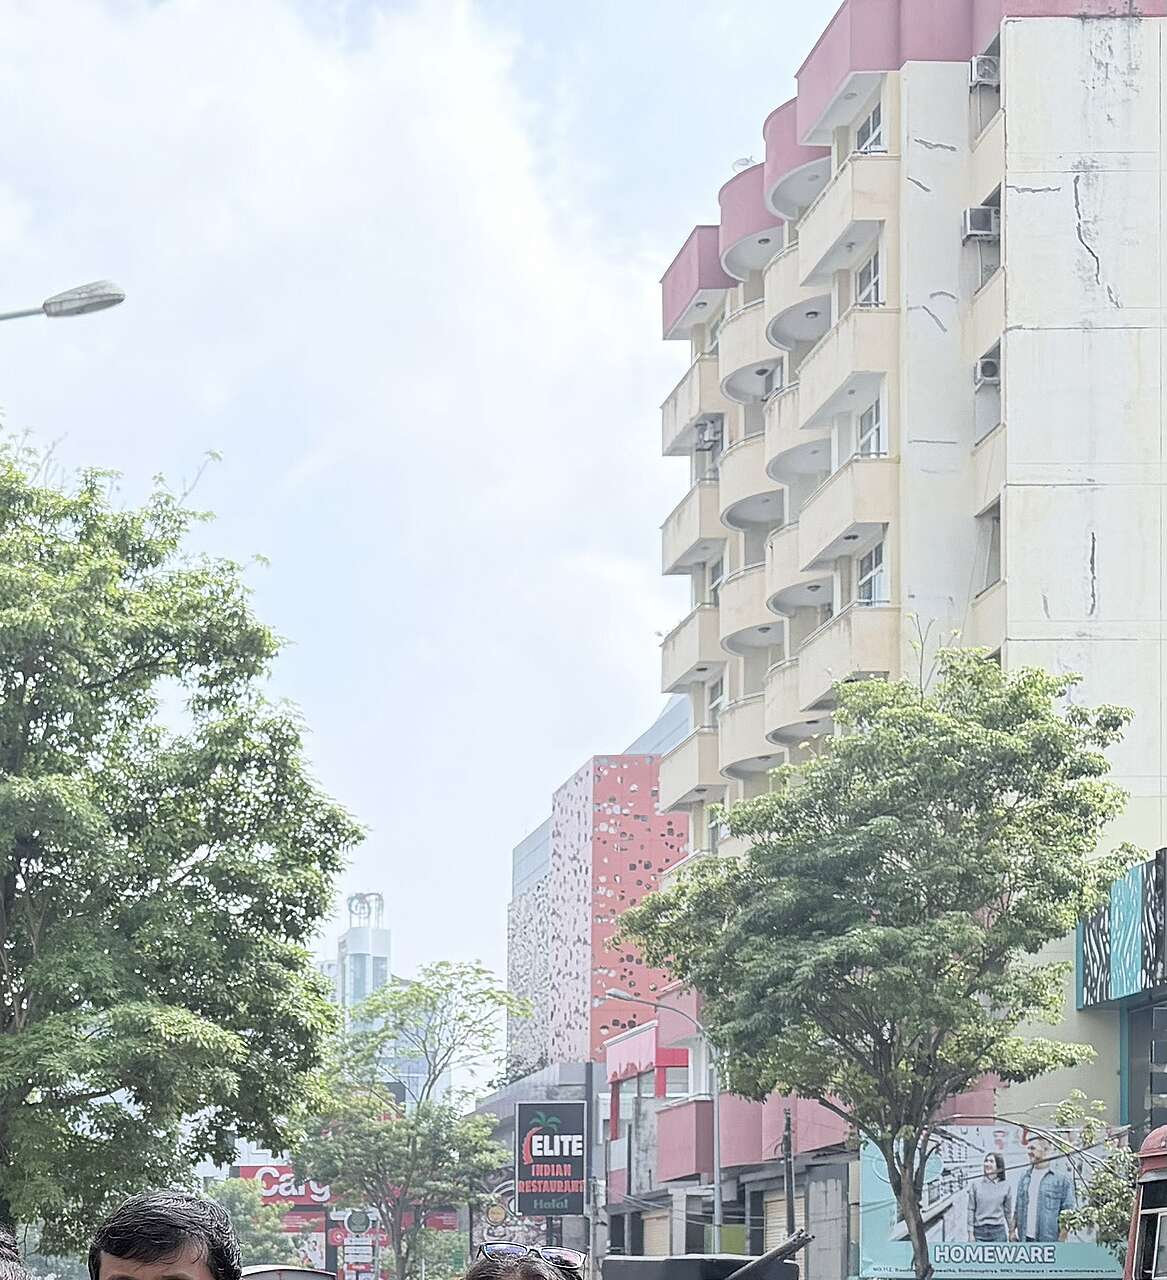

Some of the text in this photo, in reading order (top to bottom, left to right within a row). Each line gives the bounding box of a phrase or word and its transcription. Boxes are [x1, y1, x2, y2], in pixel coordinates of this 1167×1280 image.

[532, 1134, 583, 1156] ELITE
[531, 1164, 572, 1177] INDIAN
[518, 1180, 585, 1193] RESTAURANT
[935, 1245, 1056, 1265] HOMEWARE
